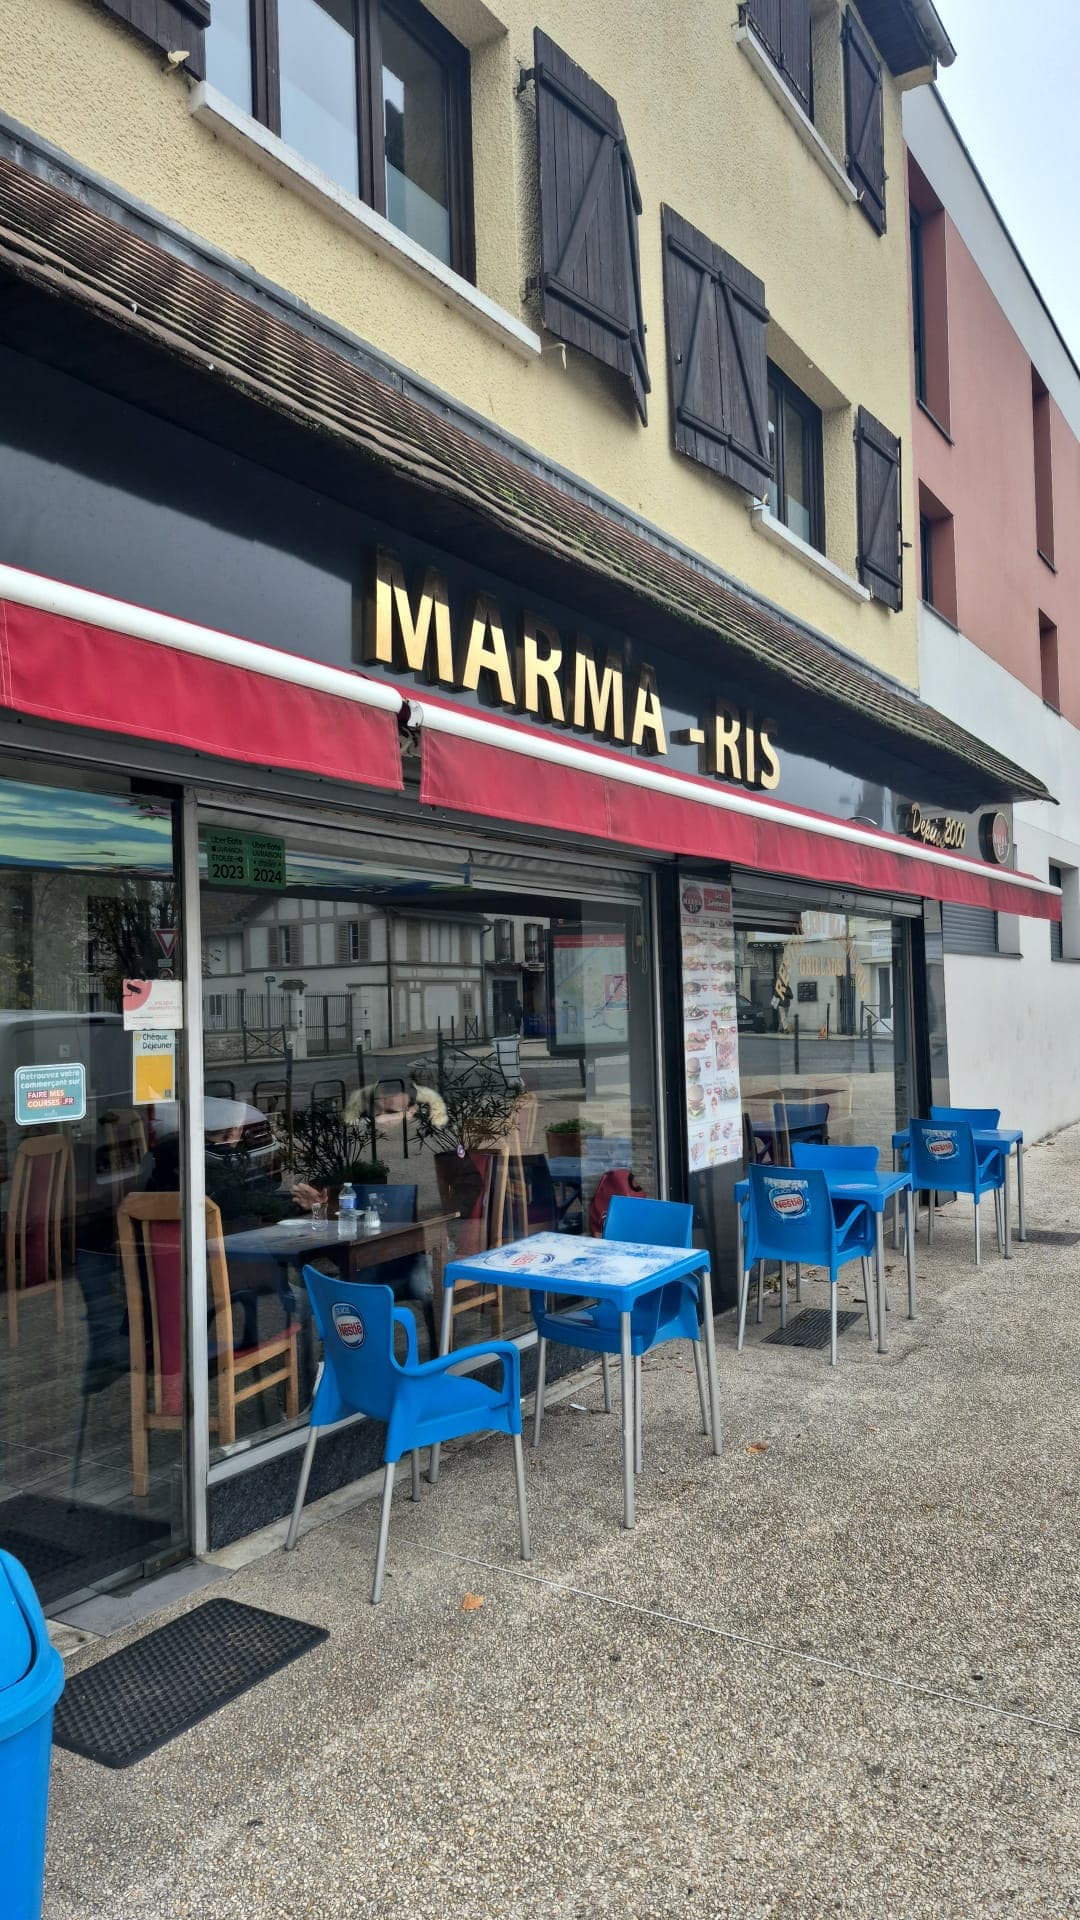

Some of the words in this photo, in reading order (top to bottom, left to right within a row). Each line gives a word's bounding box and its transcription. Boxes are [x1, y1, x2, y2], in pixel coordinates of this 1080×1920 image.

[374, 546, 668, 755] MARMA
[715, 697, 782, 791] RIS
[944, 816, 966, 848] 2000
[210, 836, 226, 844] Uber
[227, 837, 242, 845] Eats
[252, 841, 266, 849] Uber
[212, 864, 244, 879] 2023
[253, 869, 282, 883] 2024
[142, 1042, 172, 1051] Déjeuner
[20, 1072, 59, 1080] Retrouvez
[60, 1069, 80, 1077] votre
[20, 1080, 68, 1089] commerçant
[49, 1089, 65, 1097] MES
[27, 1099, 60, 1108] COURSES
